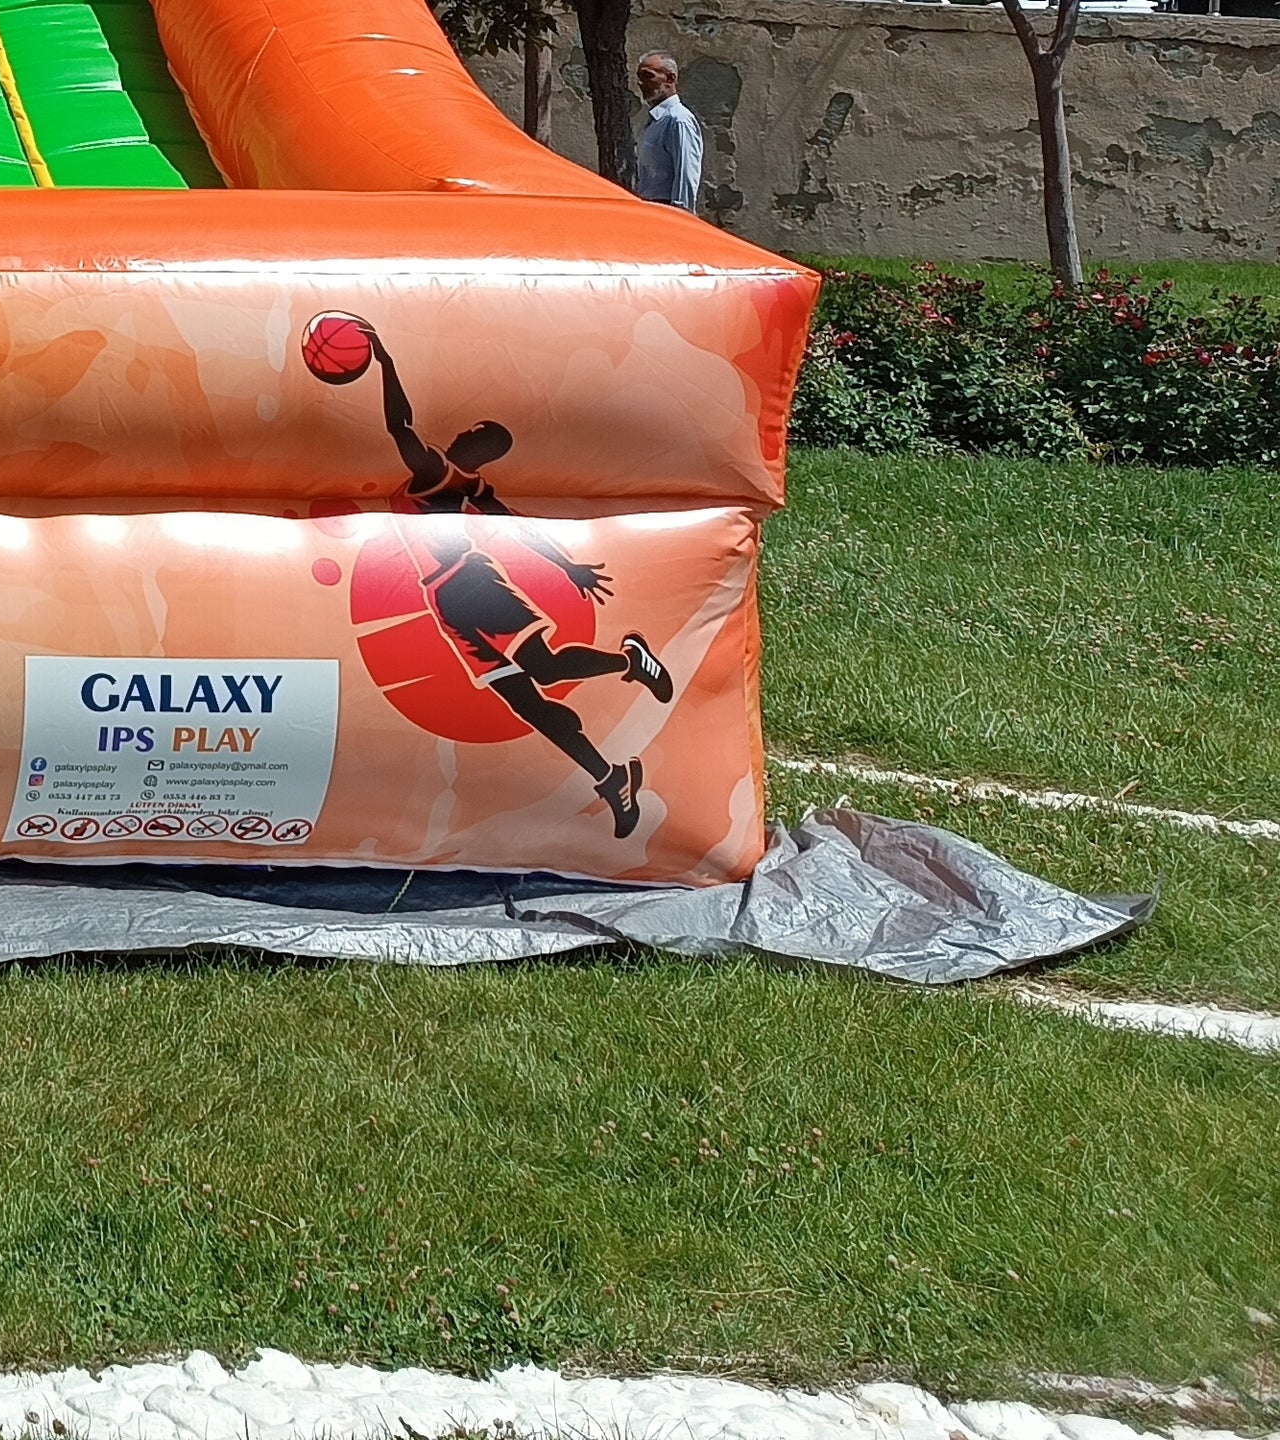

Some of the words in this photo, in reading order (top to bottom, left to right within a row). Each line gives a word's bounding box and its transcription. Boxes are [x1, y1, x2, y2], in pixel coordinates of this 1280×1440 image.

[81, 672, 284, 713] GALAXY
[98, 726, 155, 753] IPS
[172, 727, 261, 753] PLAY
[54, 763, 117, 773] galaxyipsplay
[169, 761, 289, 771] galaxyipsplay@gmail.com
[52, 780, 115, 789] galaxyipsplay
[166, 777, 276, 788] www.galaxyipsplay.com
